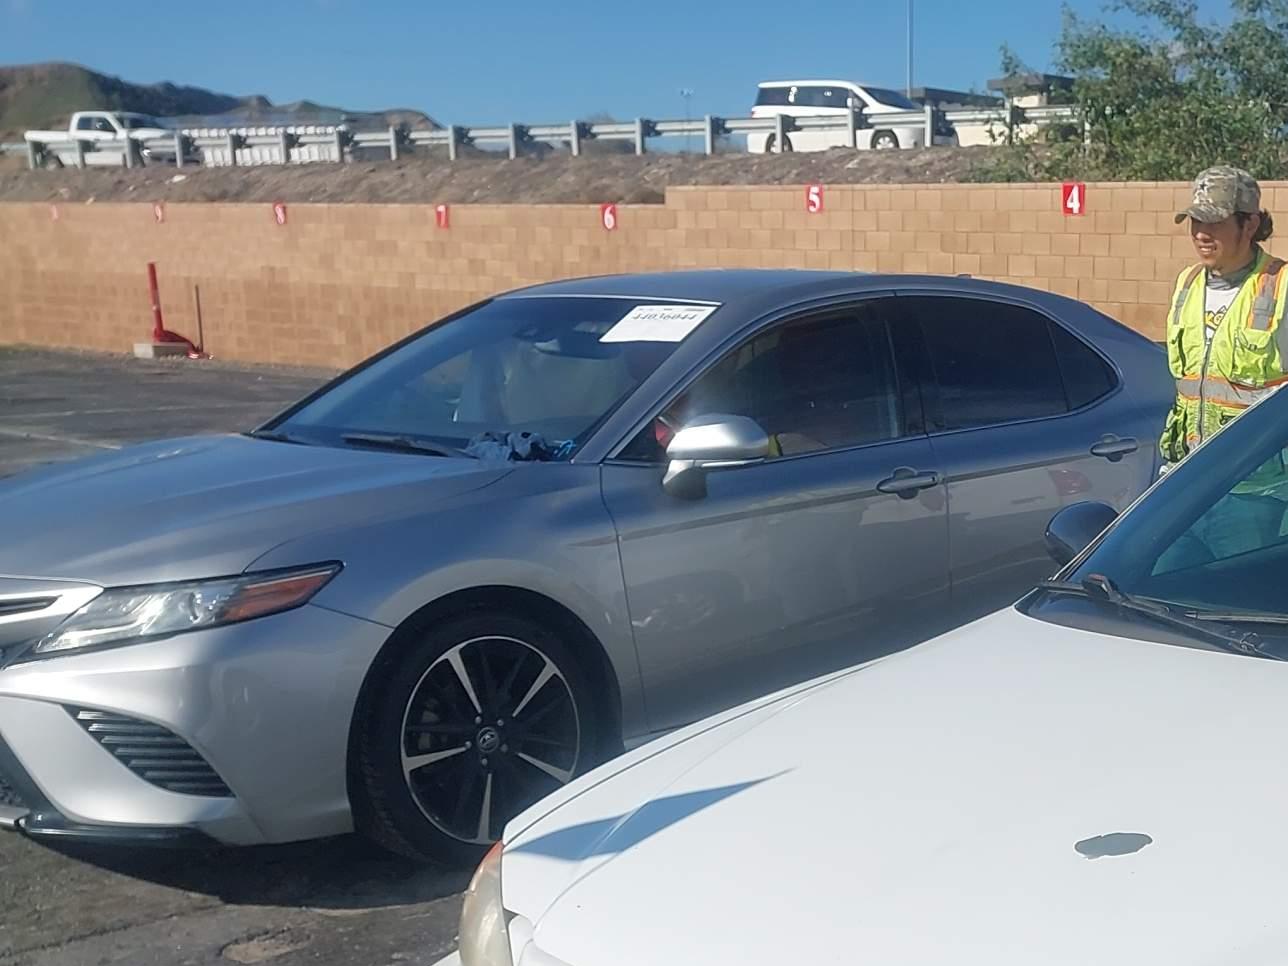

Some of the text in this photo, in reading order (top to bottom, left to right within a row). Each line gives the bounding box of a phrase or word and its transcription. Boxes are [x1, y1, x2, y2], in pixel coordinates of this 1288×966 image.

[808, 186, 820, 212] 5
[1066, 184, 1080, 214] 4
[276, 205, 285, 223] 8
[604, 206, 614, 229] 6
